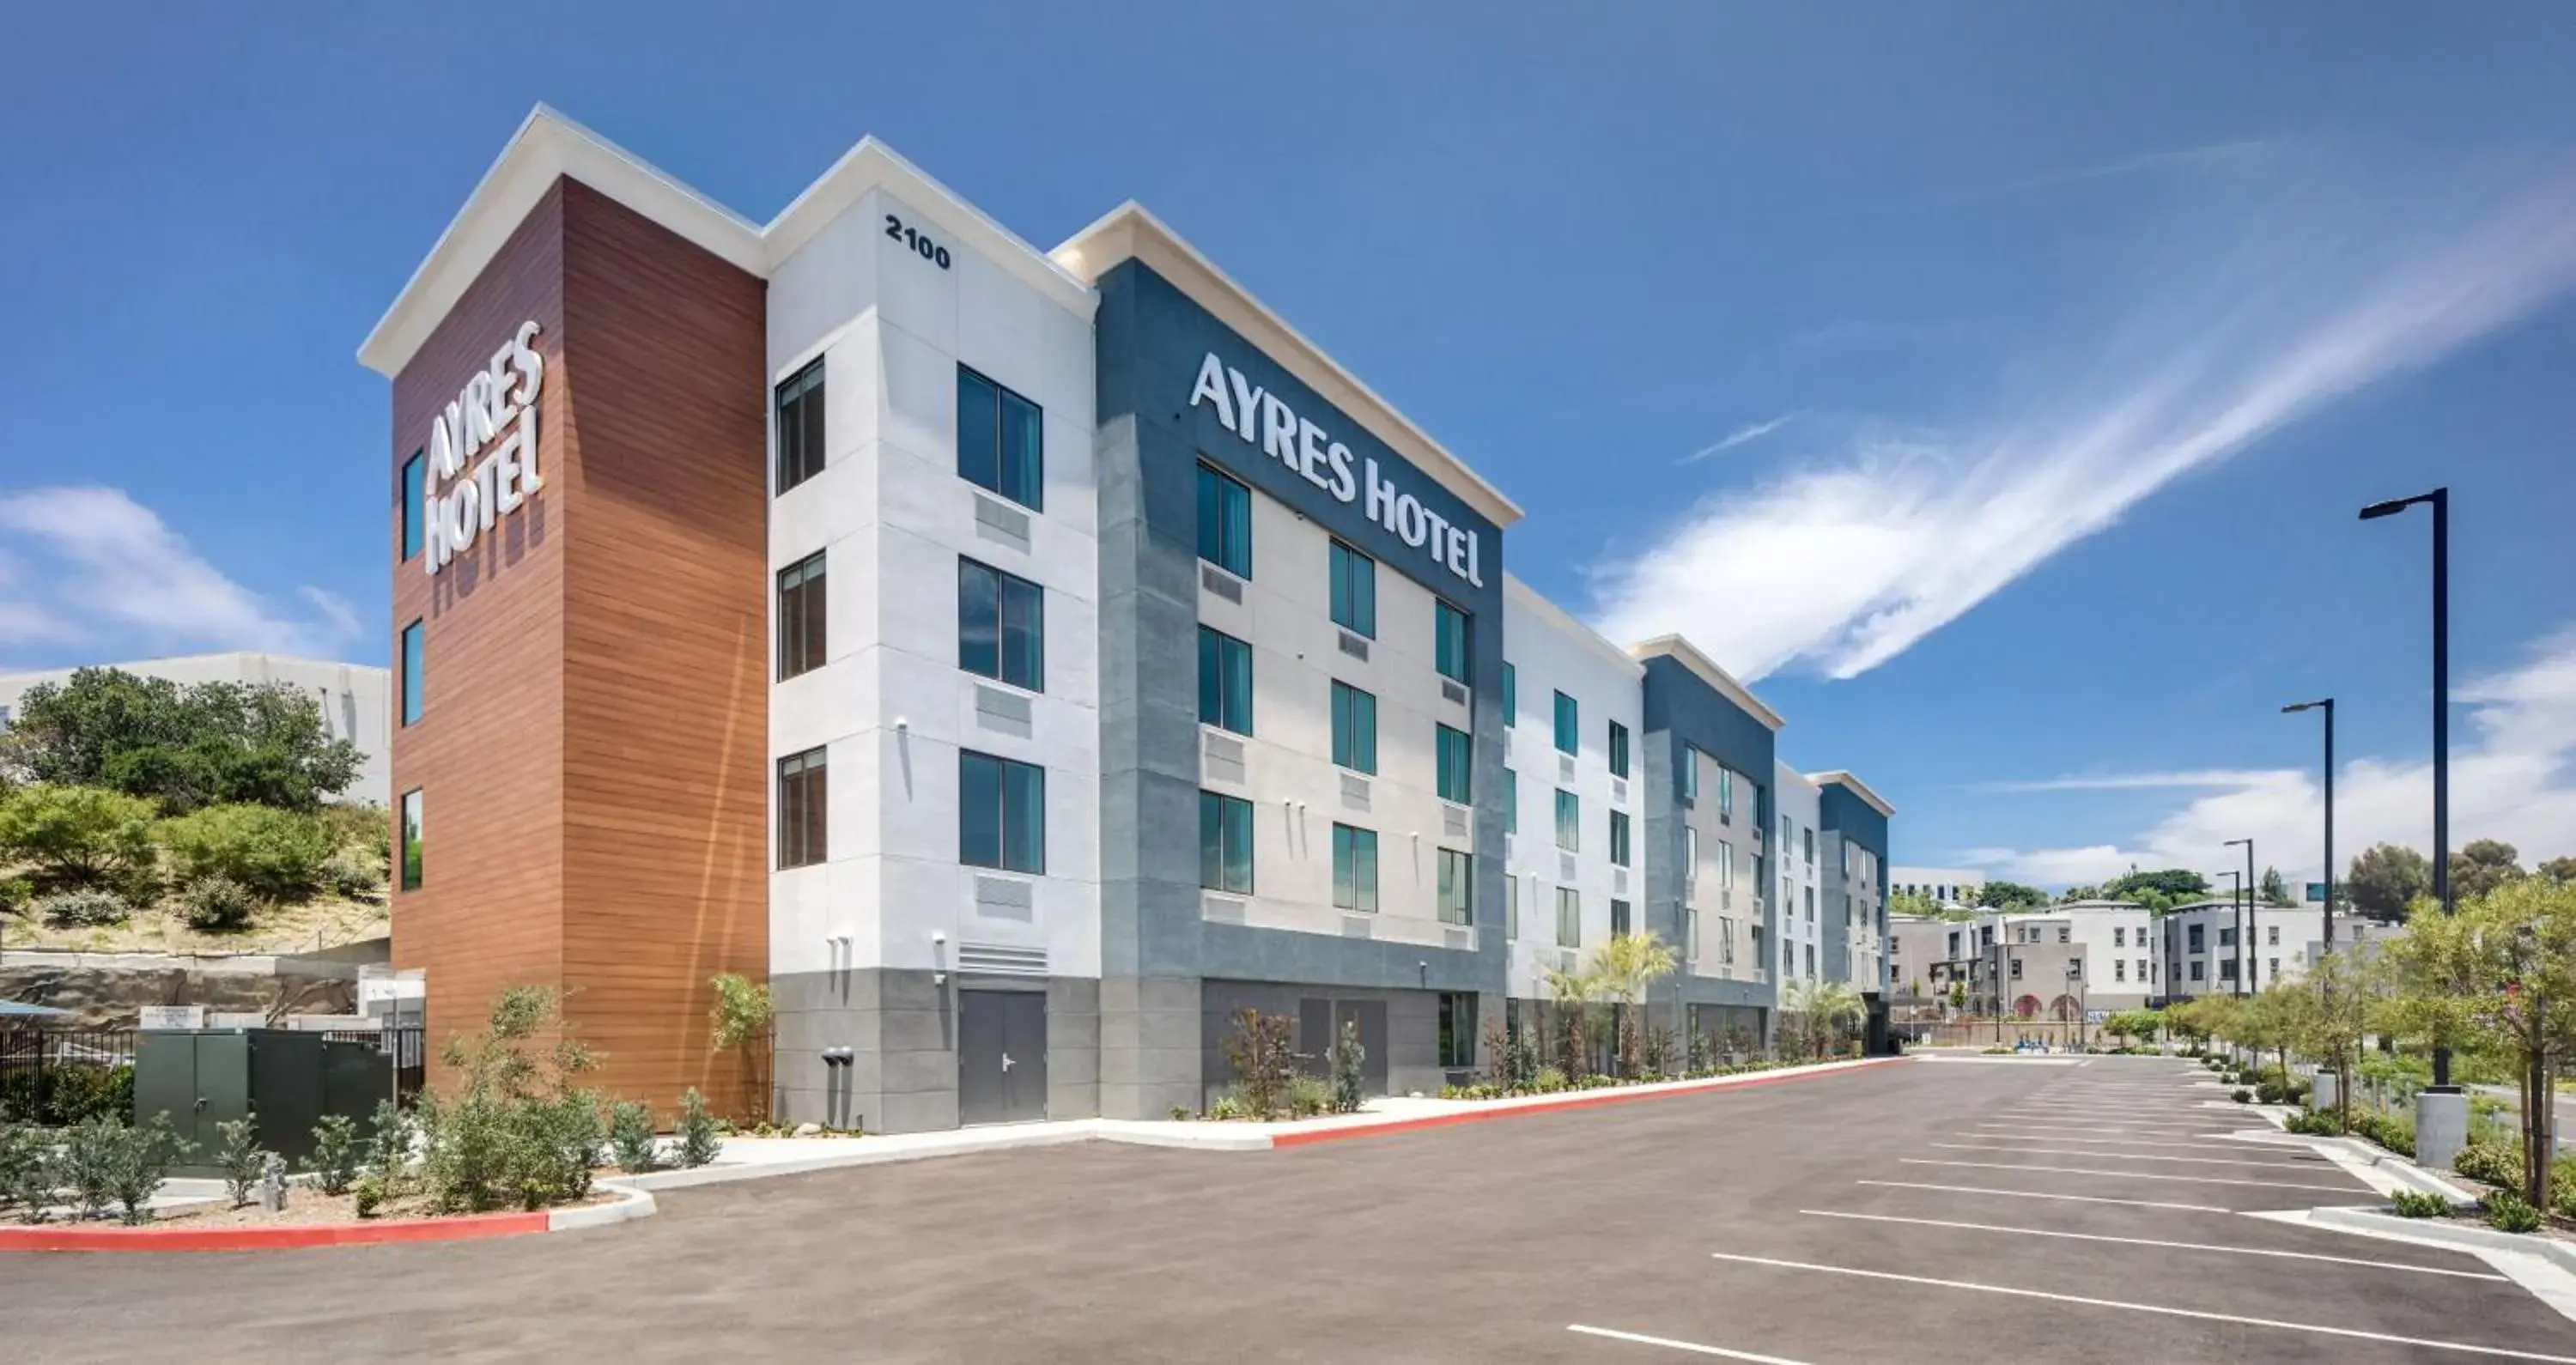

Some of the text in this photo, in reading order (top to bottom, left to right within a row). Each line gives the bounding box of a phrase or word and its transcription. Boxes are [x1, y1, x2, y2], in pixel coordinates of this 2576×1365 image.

[885, 214, 951, 270] 2100
[426, 320, 543, 494] AYRES
[426, 405, 544, 575] HOTEL
[1190, 353, 1483, 588] AYRES HOTEL
